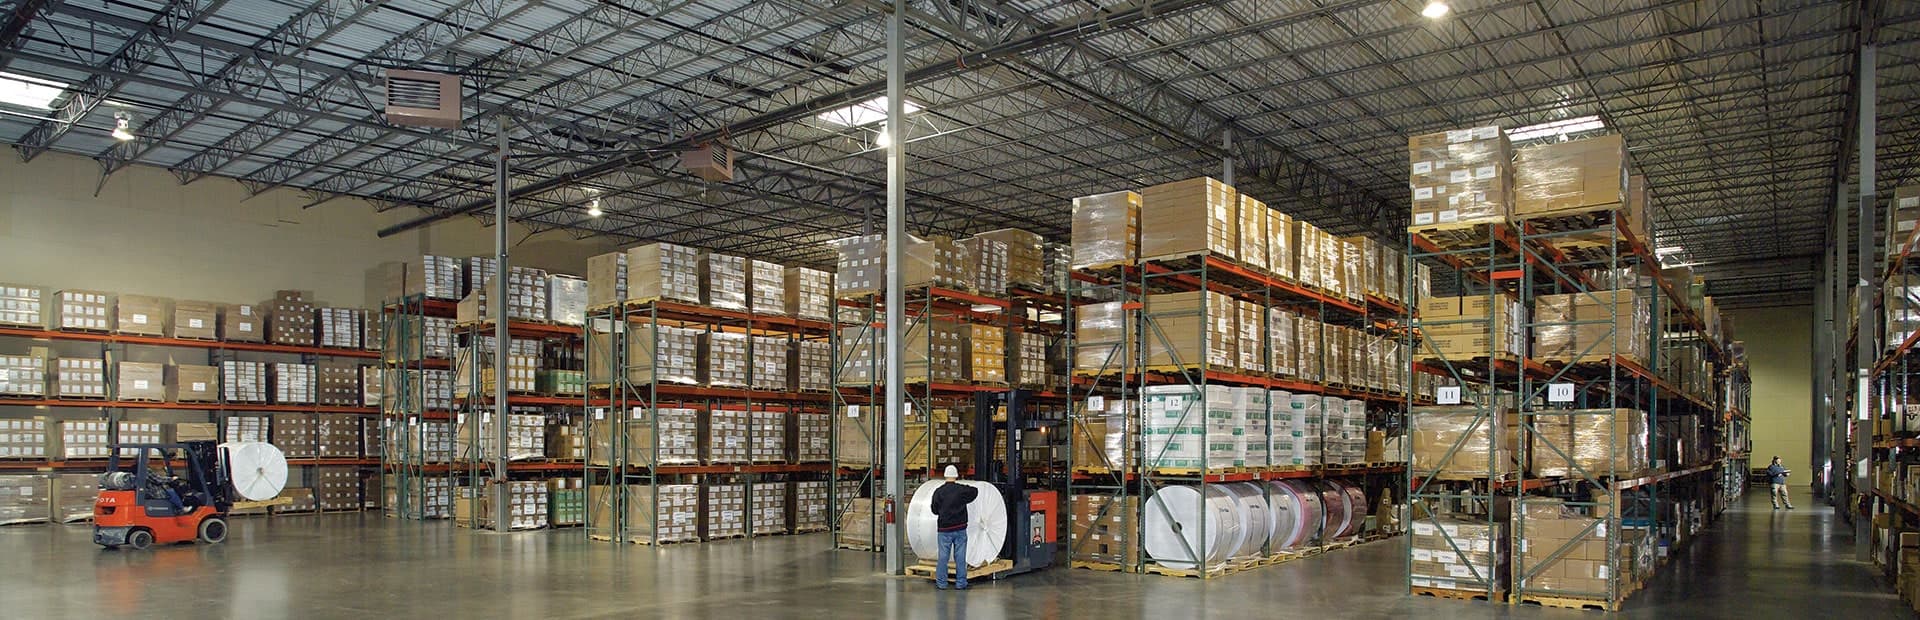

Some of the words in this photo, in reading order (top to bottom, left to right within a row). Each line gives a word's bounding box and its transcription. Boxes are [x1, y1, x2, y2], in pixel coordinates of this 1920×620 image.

[1444, 391, 1454, 399] 11
[1557, 387, 1568, 397] 10
[1170, 398, 1179, 406] 12
